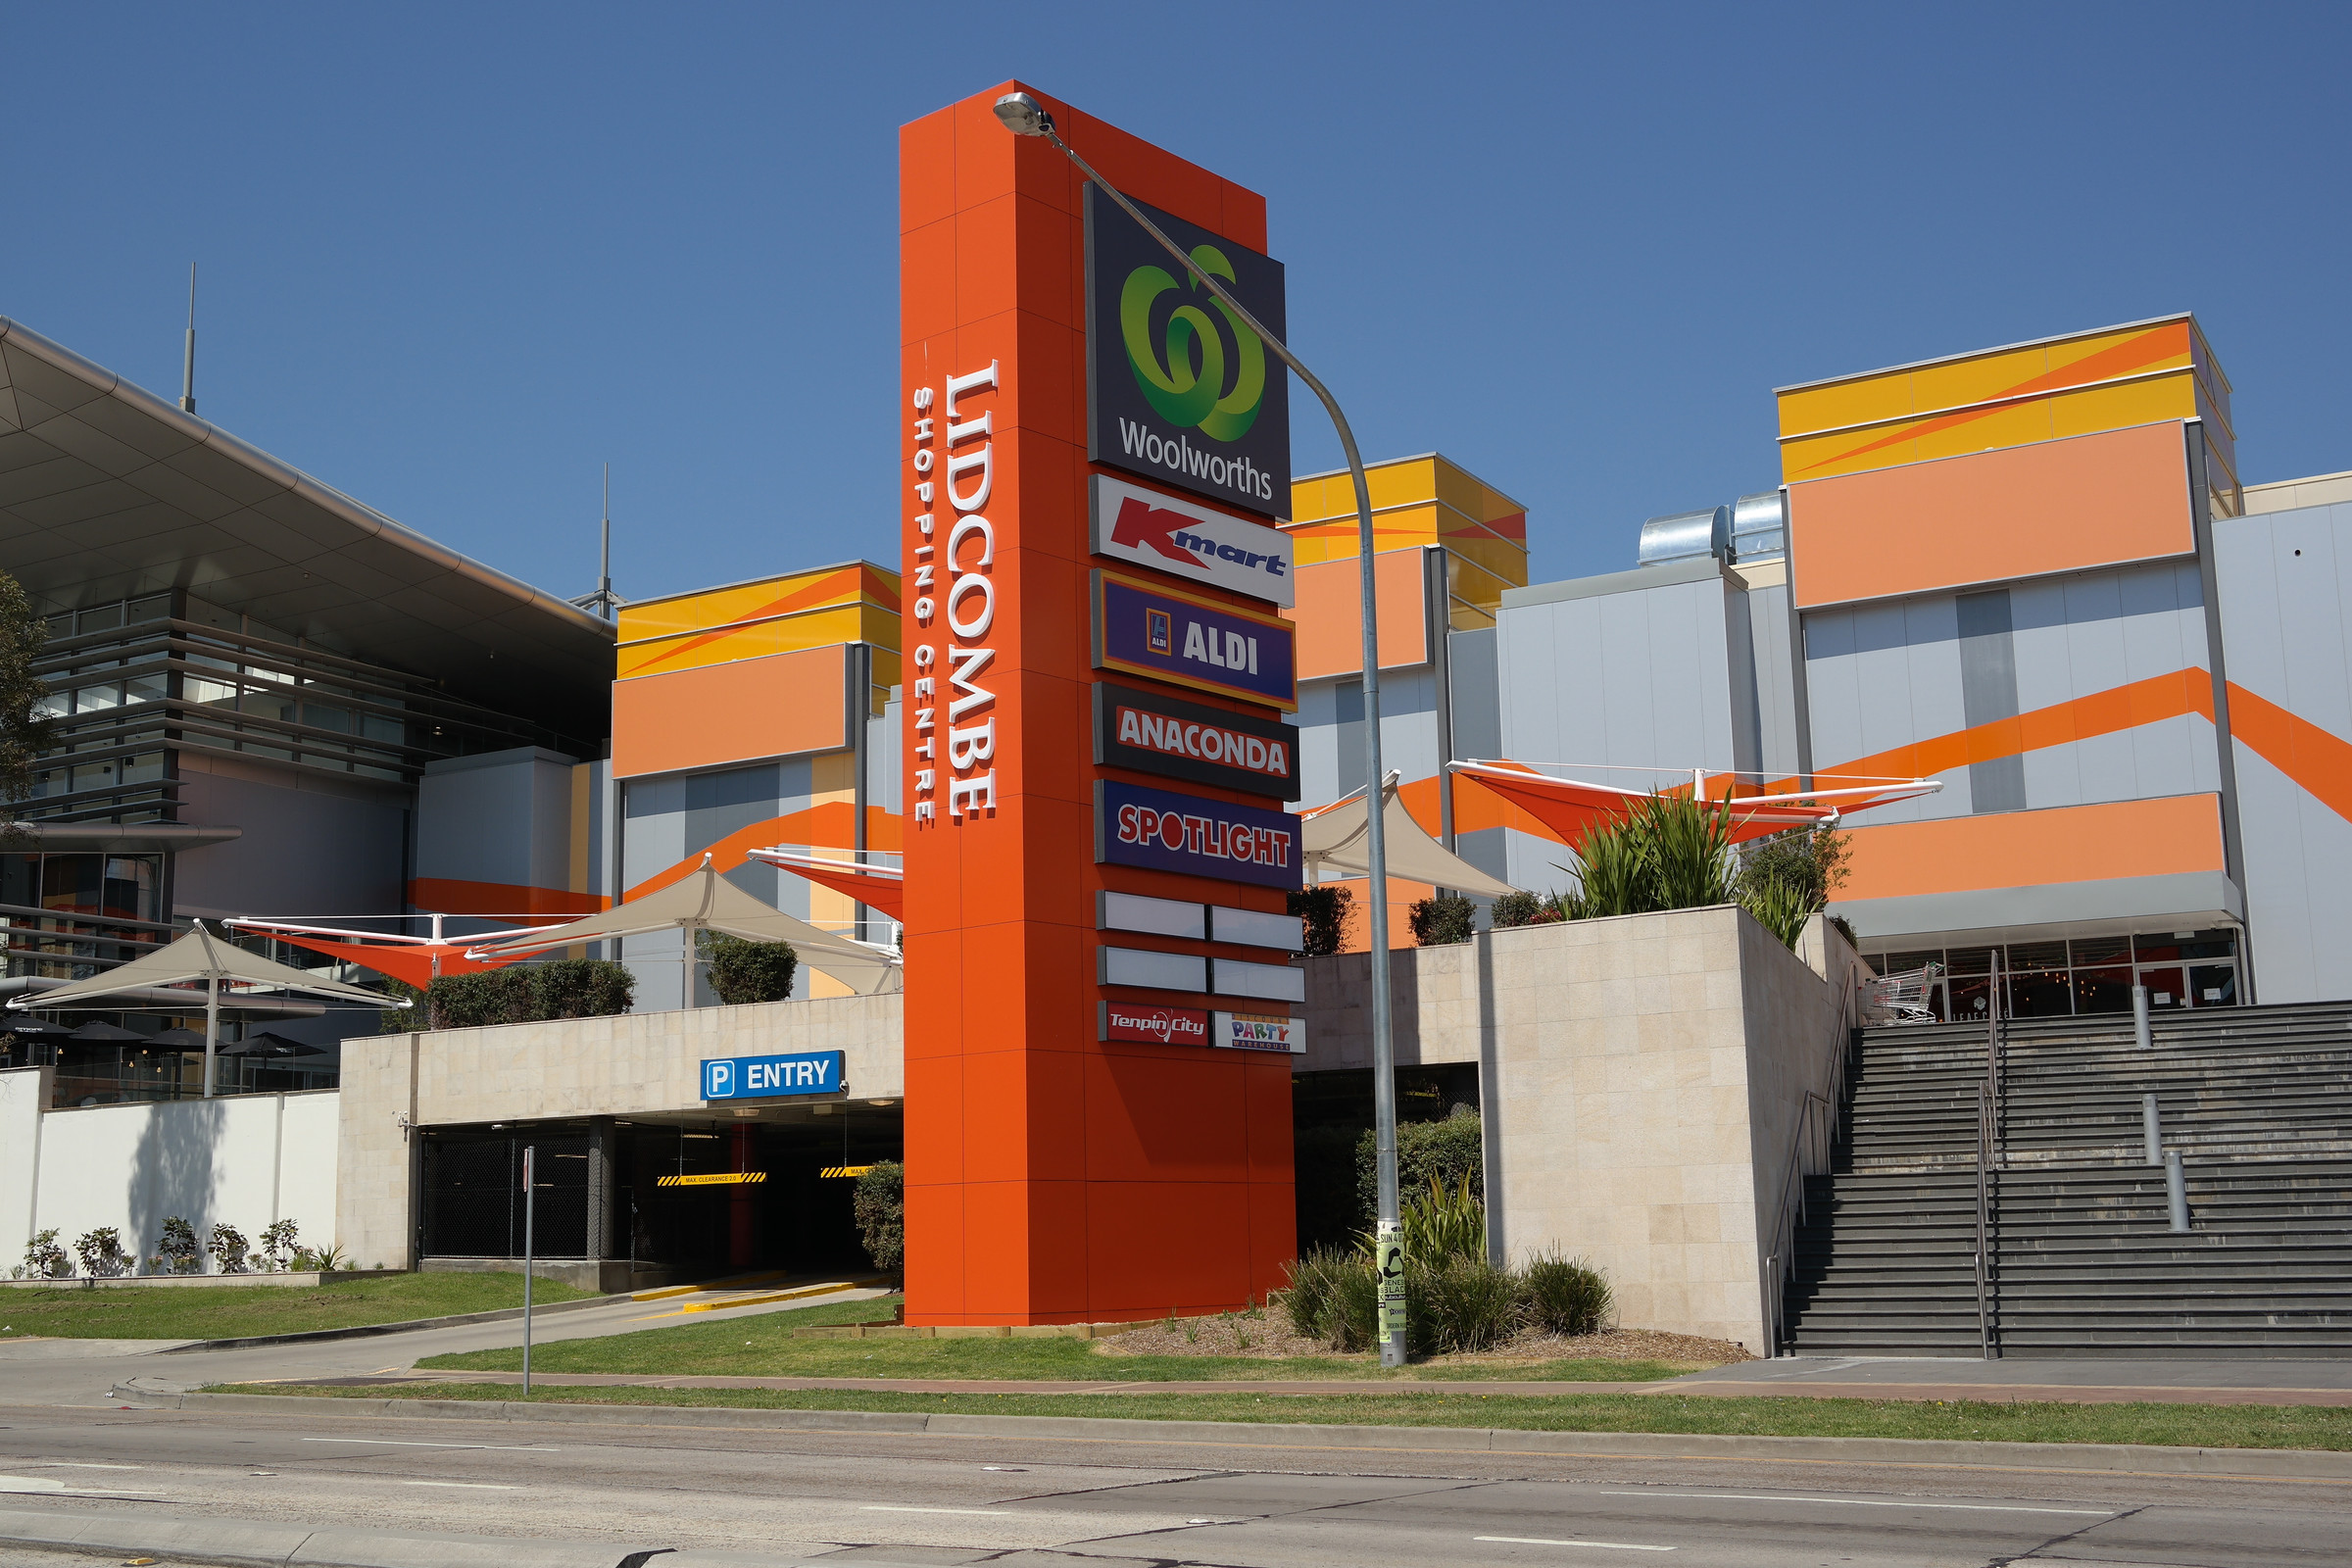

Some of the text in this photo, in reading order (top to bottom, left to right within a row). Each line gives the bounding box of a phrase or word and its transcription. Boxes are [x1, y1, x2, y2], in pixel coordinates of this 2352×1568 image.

[1119, 416, 1273, 501] Woolworths
[1110, 496, 1287, 577] Kmart
[914, 387, 934, 821] SHOPPING CENTRE
[947, 359, 999, 816] LIDCOMBE
[1152, 637, 1167, 648] ALDI
[1183, 621, 1258, 675] ALDI
[1119, 710, 1287, 775] ANACONDA
[1117, 803, 1292, 868] SPOTLIGHT
[1110, 1013, 1205, 1036] Tenpin City
[1231, 1021, 1290, 1042] PARTY
[1232, 1013, 1290, 1024] DISCOUNT
[1233, 1040, 1290, 1051] WAREHOUSE
[712, 1059, 830, 1093] P ENTRY
[1381, 1233, 1393, 1243] SUN
